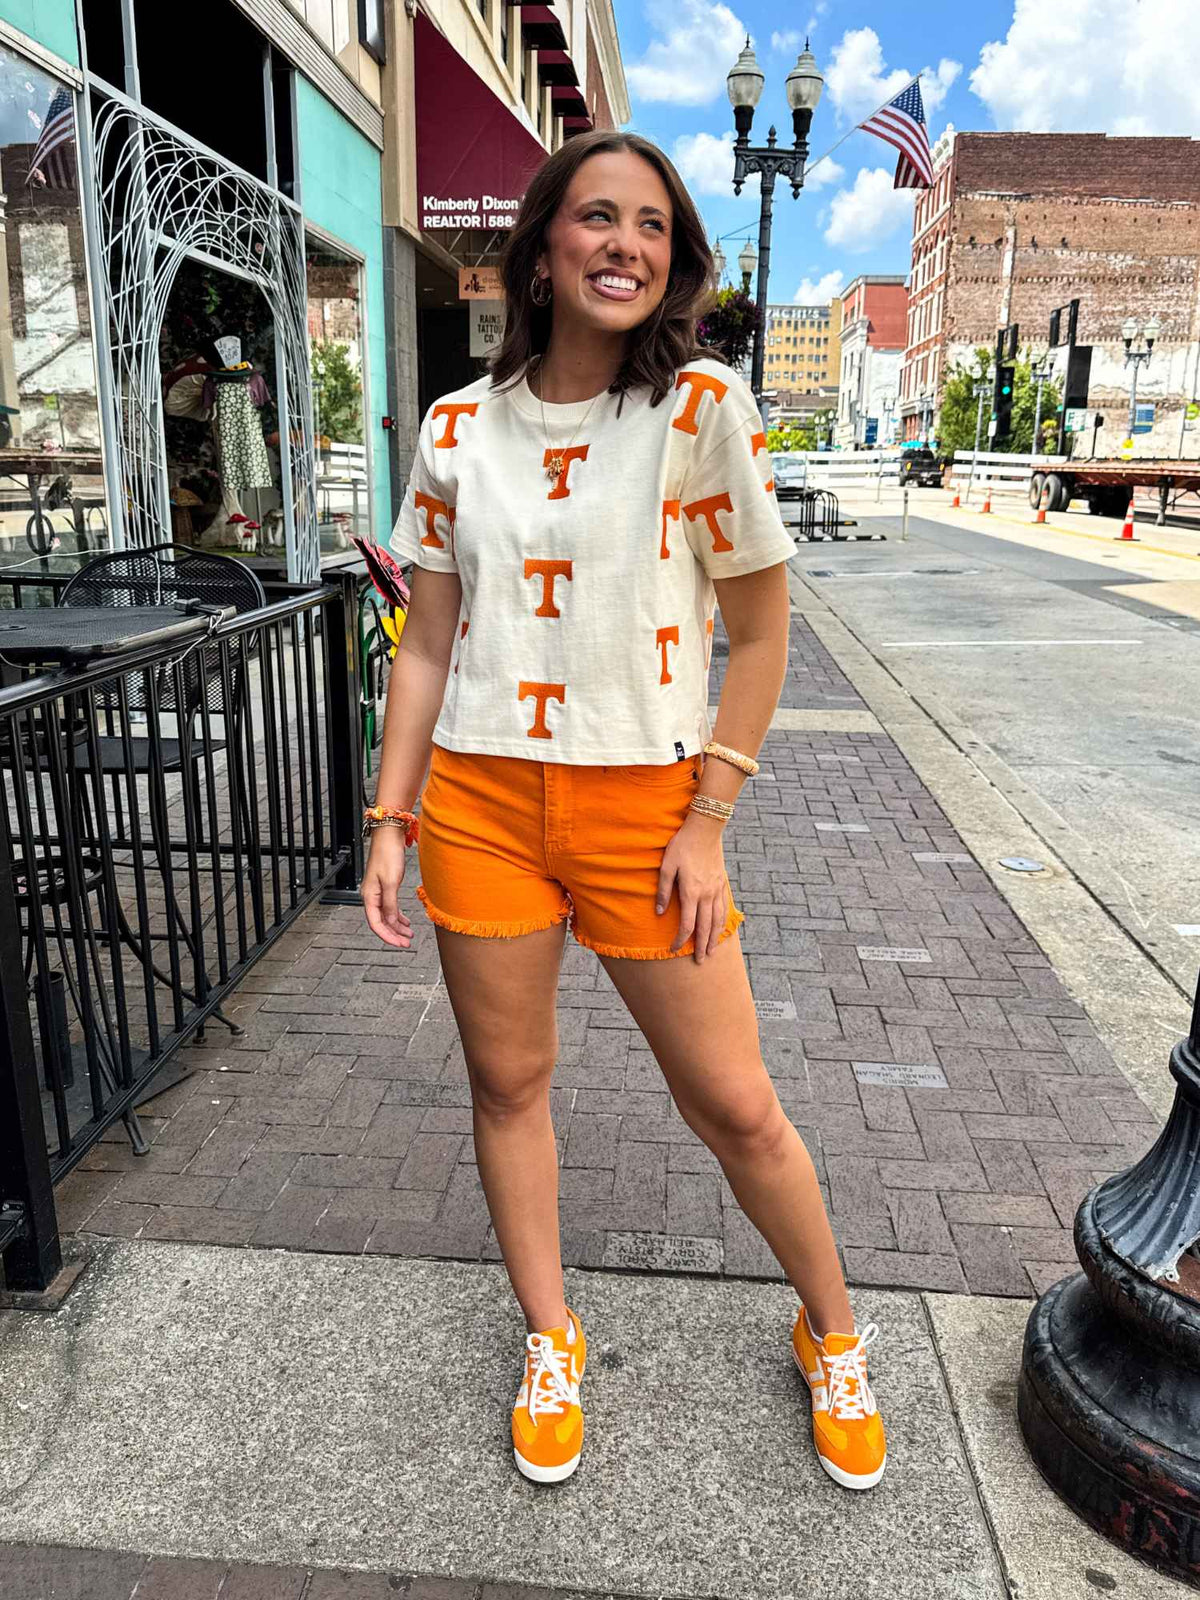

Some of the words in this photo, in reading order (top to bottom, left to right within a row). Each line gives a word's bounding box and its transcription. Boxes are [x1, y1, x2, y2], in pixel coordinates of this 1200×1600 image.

[423, 196, 479, 212] Kimberly
[482, 195, 518, 210] Dixon
[423, 215, 480, 228] REALTOR
[432, 403, 479, 449] T
[671, 371, 729, 436] T
[543, 444, 590, 500] T
[681, 491, 734, 553] T
[524, 559, 573, 619] T
[518, 681, 566, 739] T
